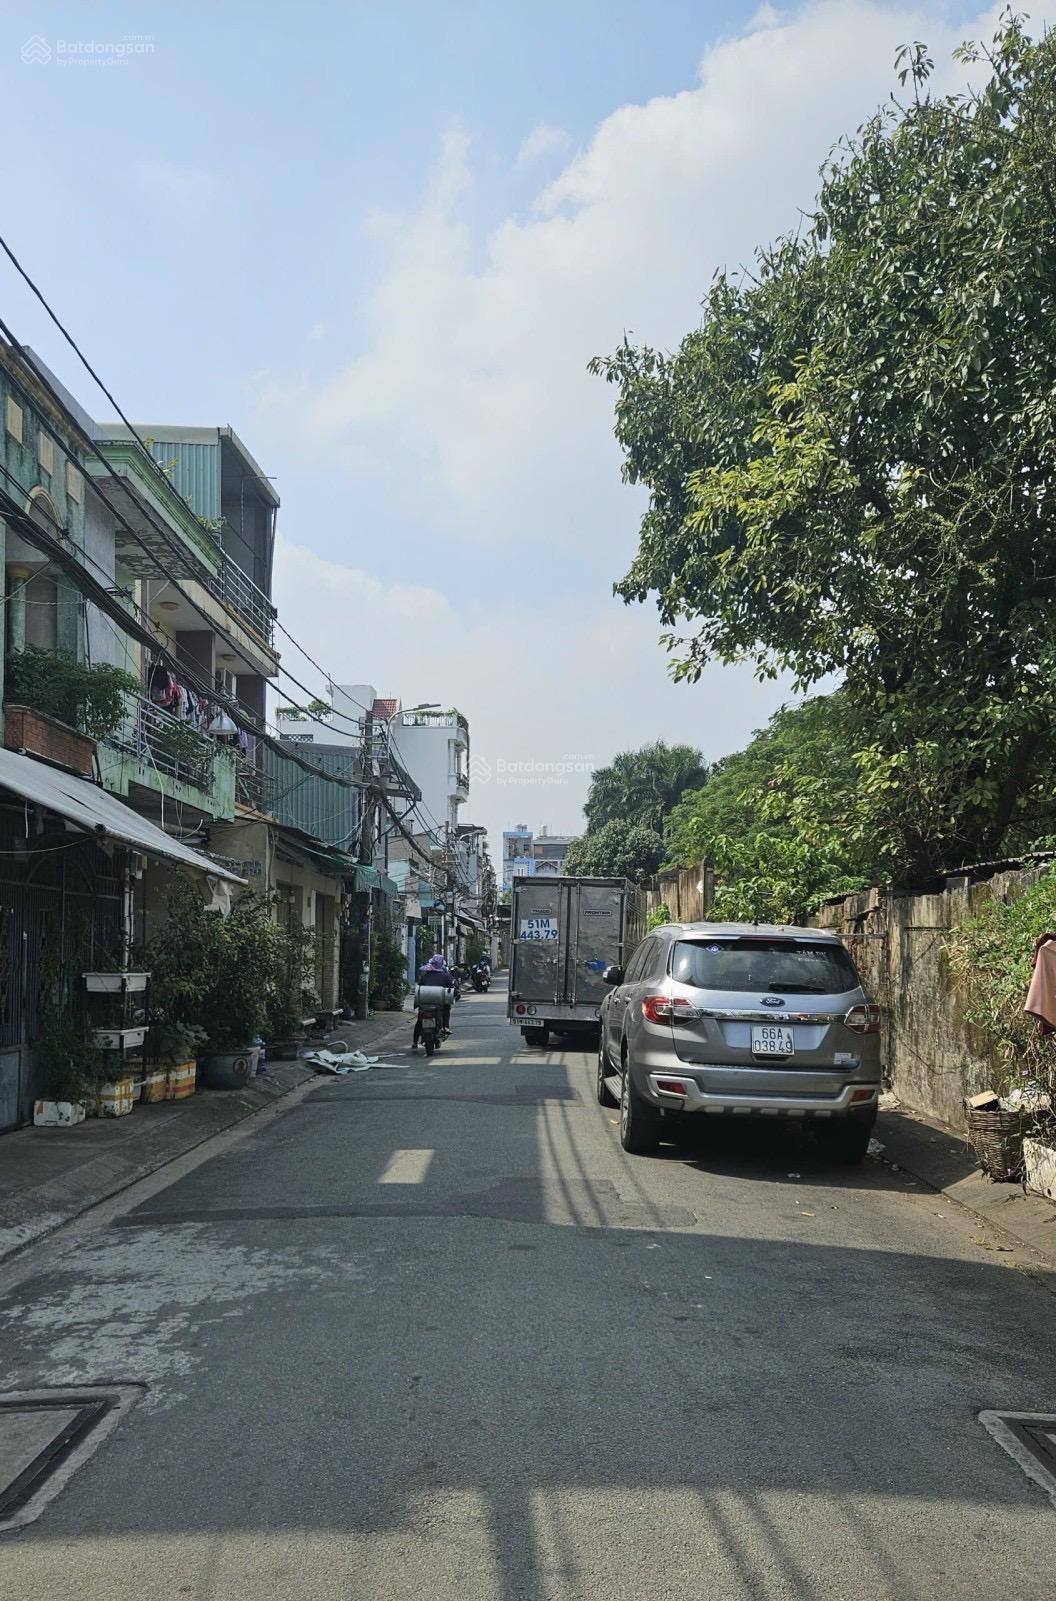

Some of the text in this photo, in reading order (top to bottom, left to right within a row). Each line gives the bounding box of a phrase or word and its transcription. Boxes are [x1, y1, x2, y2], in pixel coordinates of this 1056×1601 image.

[527, 919, 550, 929] 51M
[520, 929, 558, 940] 443.79
[762, 1027, 784, 1040] 66A
[754, 1039, 793, 1053] 038.49
